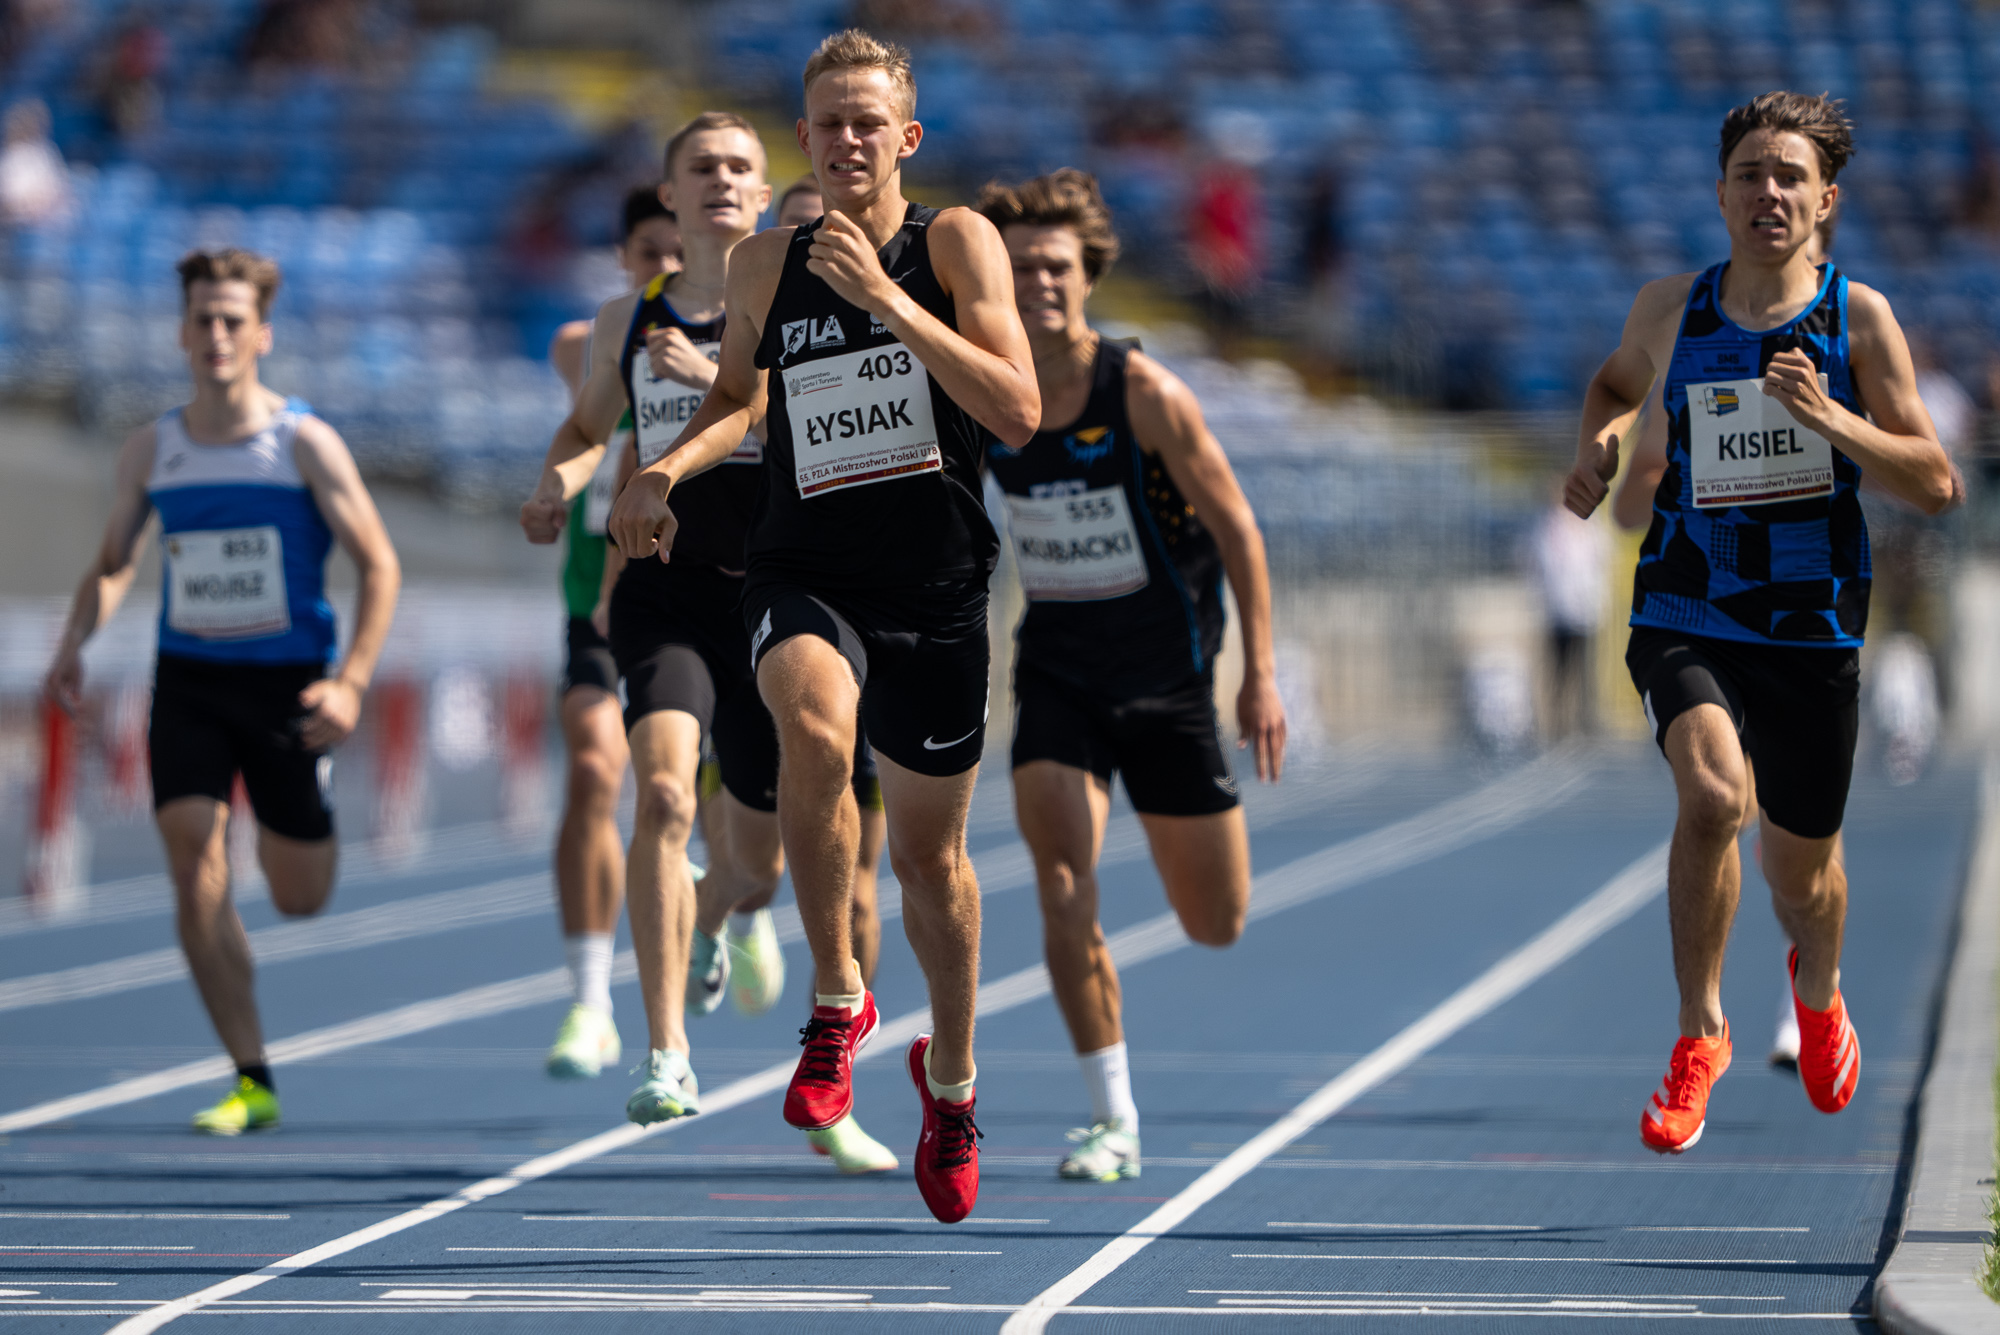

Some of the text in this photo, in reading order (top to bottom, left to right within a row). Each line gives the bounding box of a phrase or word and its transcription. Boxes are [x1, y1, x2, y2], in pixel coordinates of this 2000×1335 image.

[857, 350, 912, 381] 403
[1717, 353, 1739, 365] SMS
[800, 371, 831, 383] Ministerstwo
[801, 381, 815, 390] Sportu
[819, 375, 843, 385] Turystyki
[640, 393, 706, 429] ŚMIER
[806, 398, 914, 446] ŁYSIAK
[1718, 428, 1804, 461] KISIEL
[799, 446, 938, 483] 55. PZLA Mistrzostwa Polski U18
[1711, 483, 1732, 493] PZLA
[1734, 480, 1784, 492] Mistrzostwa
[1787, 475, 1813, 486] Polski
[1815, 472, 1832, 482] U18
[1019, 528, 1133, 564] KUBACKI
